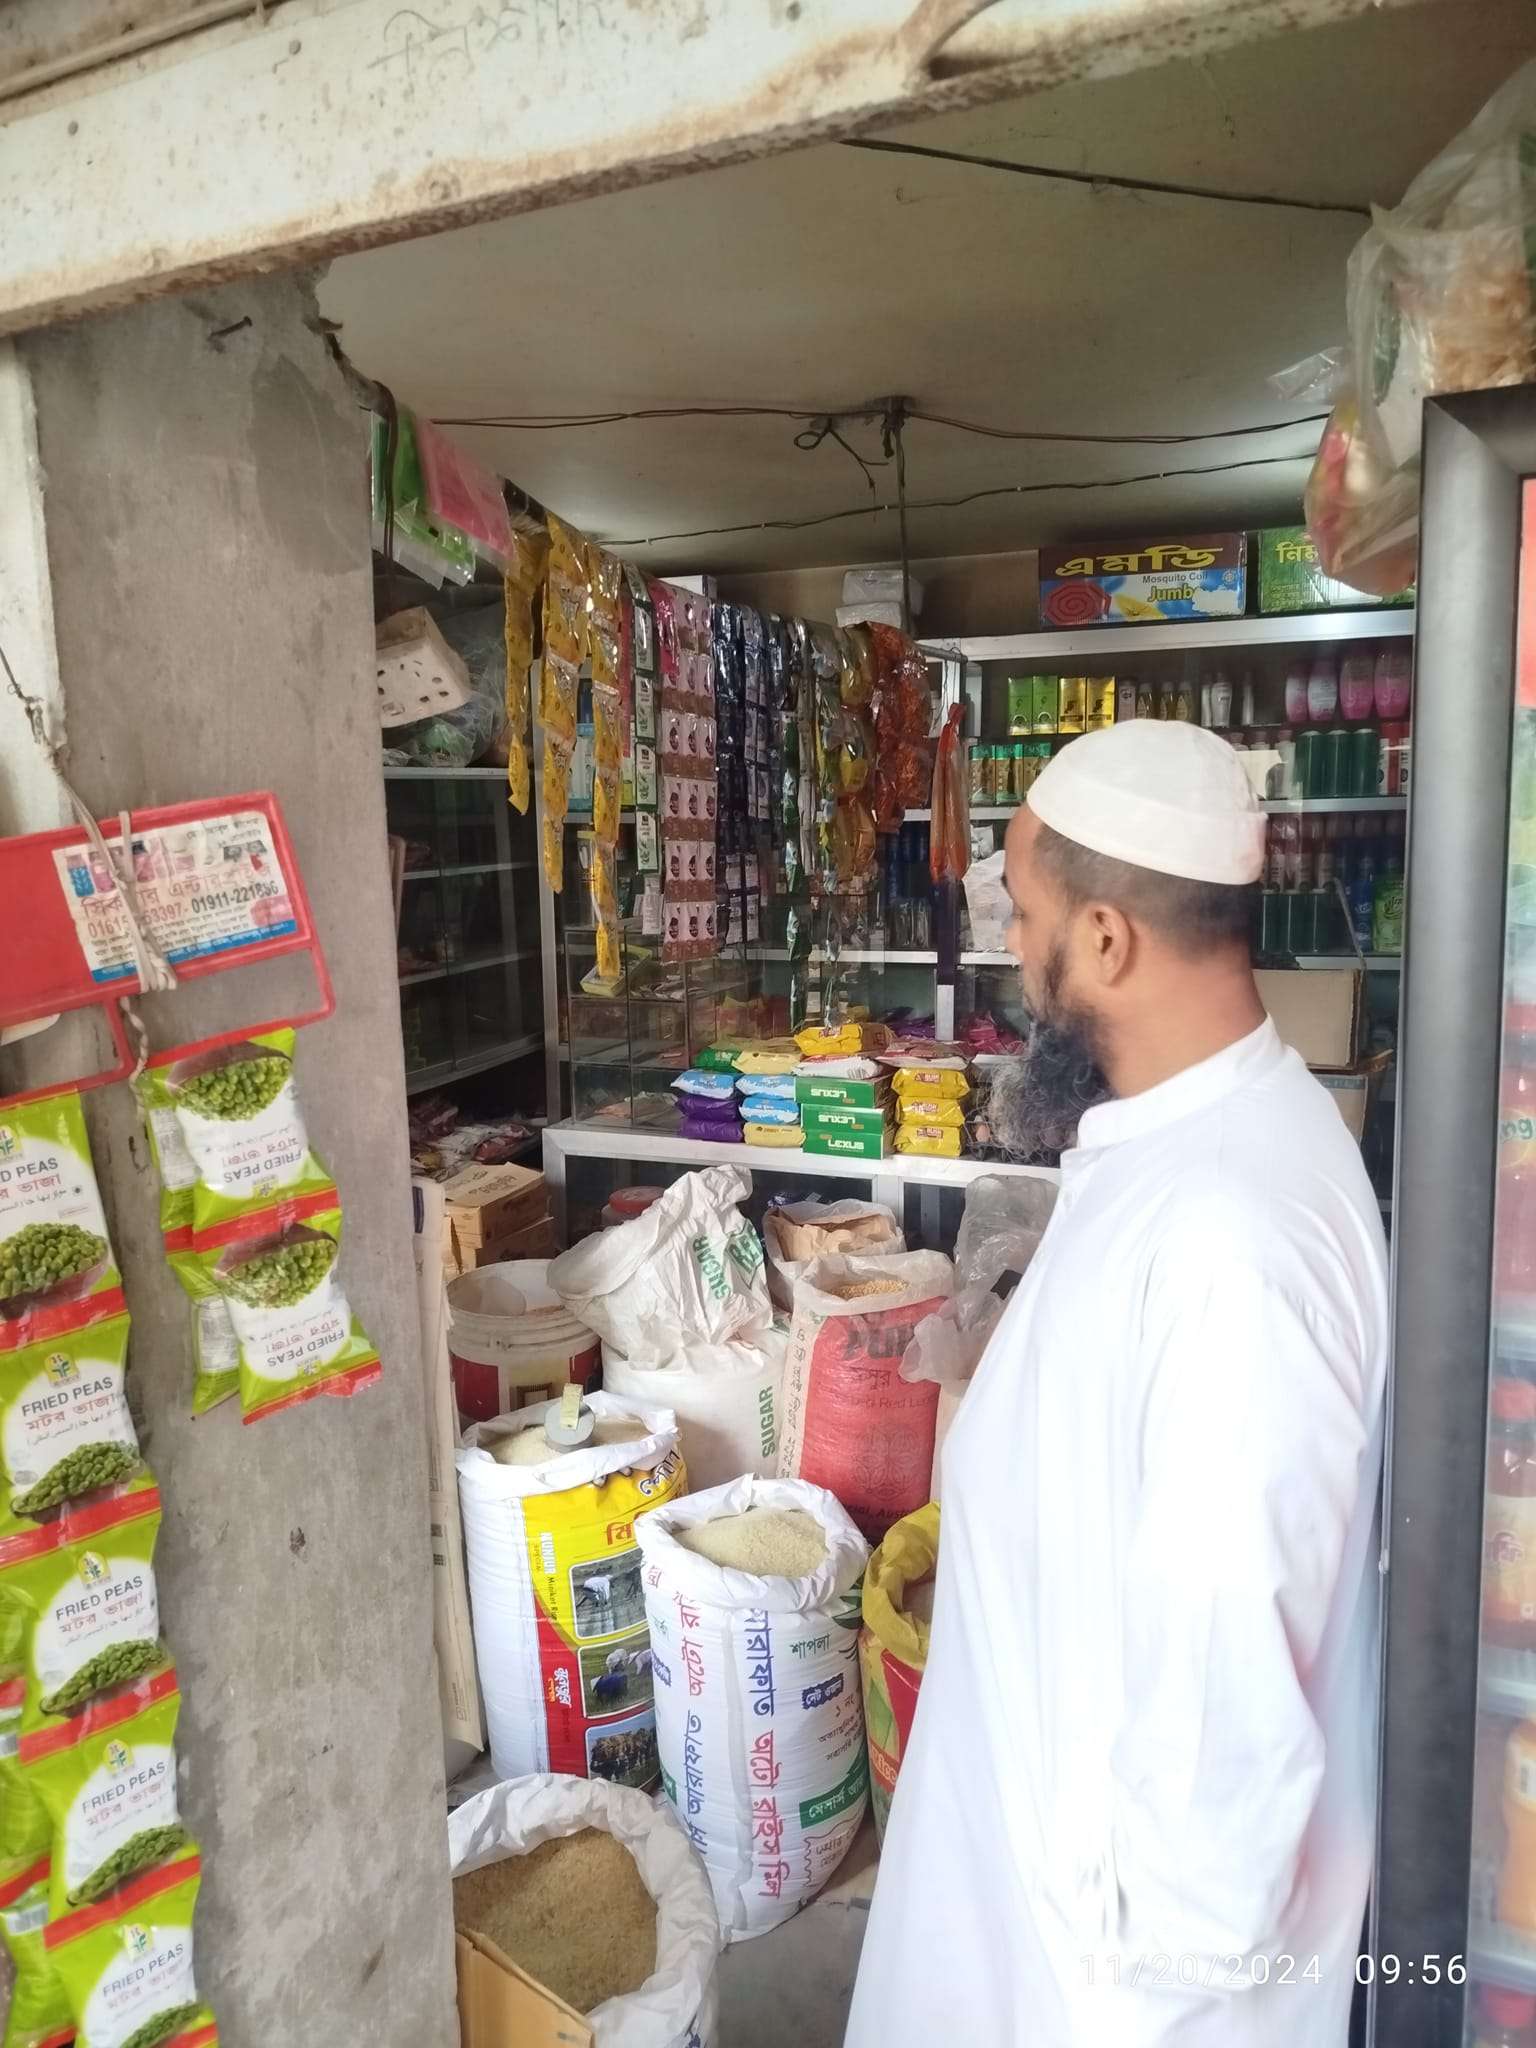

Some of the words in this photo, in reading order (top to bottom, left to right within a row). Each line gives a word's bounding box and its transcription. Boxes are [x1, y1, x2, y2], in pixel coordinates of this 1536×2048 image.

[1056, 545, 1223, 576] এমডি
[1142, 574, 1186, 584] Mosquito
[1189, 572, 1208, 581] Coil
[811, 1088, 847, 1098] LEXUS
[818, 1114, 856, 1125] LEXUS
[264, 1150, 301, 1170] FRIED
[828, 1139, 864, 1150] LEXUS
[16, 1157, 59, 1178] PEAS
[224, 1164, 260, 1183] PEAS
[693, 1236, 732, 1299] SUGAR
[267, 1346, 304, 1367] PEAS
[306, 1329, 344, 1351] FRIED
[22, 1392, 69, 1416] FRIED
[73, 1376, 113, 1400] PEAS
[759, 1385, 775, 1459] SUGAR
[56, 1594, 100, 1620] FRIED
[105, 1575, 143, 1601] PEAS
[789, 1633, 831, 1659] শাপলা
[681, 1636, 706, 1697] অটো
[683, 1709, 705, 1815] আরাফাত
[750, 1730, 783, 1789] অটো
[82, 1784, 126, 1815] FRIED
[129, 1762, 166, 1789] PEAS
[752, 1796, 784, 1856] রাইস
[758, 1859, 790, 1899] মিল
[102, 1967, 145, 1997] FRIED
[150, 1943, 184, 1971] PEAS
